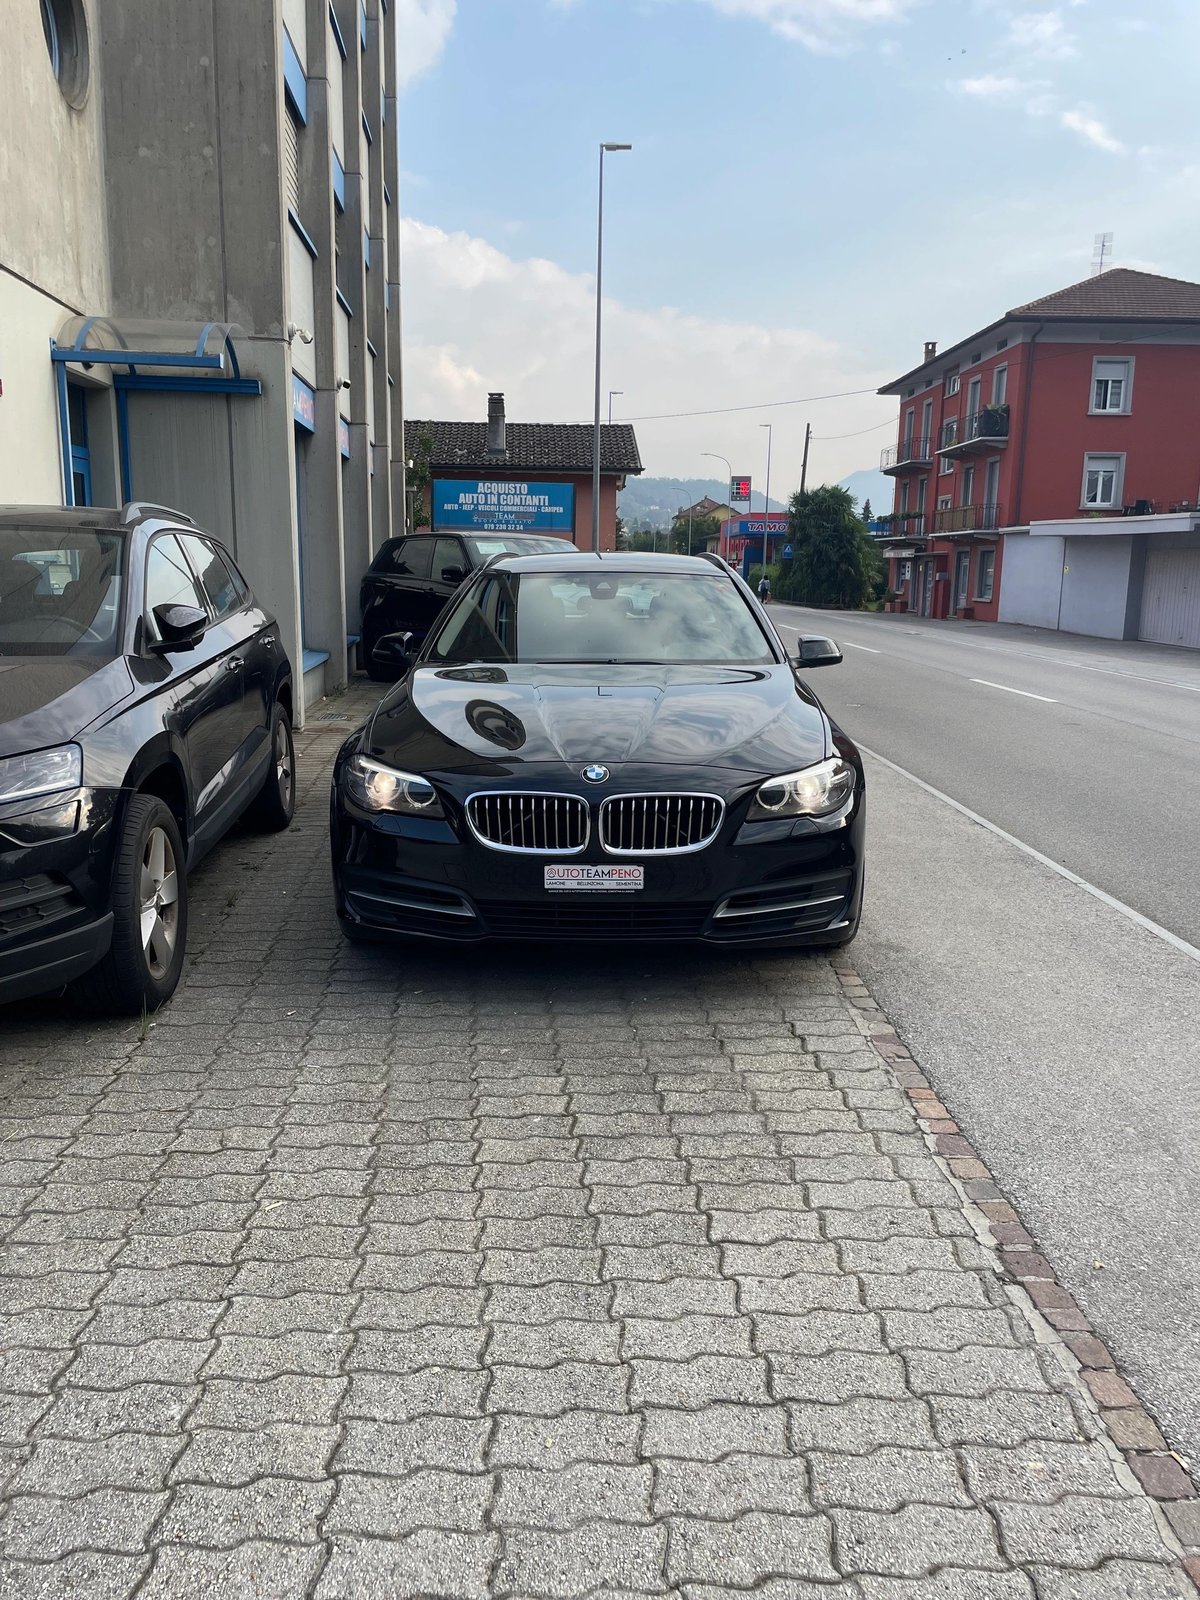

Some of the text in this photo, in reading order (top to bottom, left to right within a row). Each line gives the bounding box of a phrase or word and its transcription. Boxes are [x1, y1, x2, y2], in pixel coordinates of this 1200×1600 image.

[478, 482, 528, 494] ACQUISTO
[459, 493, 548, 506] AUTO IN CONTANTI
[500, 505, 537, 513] COMMERCIALI
[748, 522, 787, 532] TAMO
